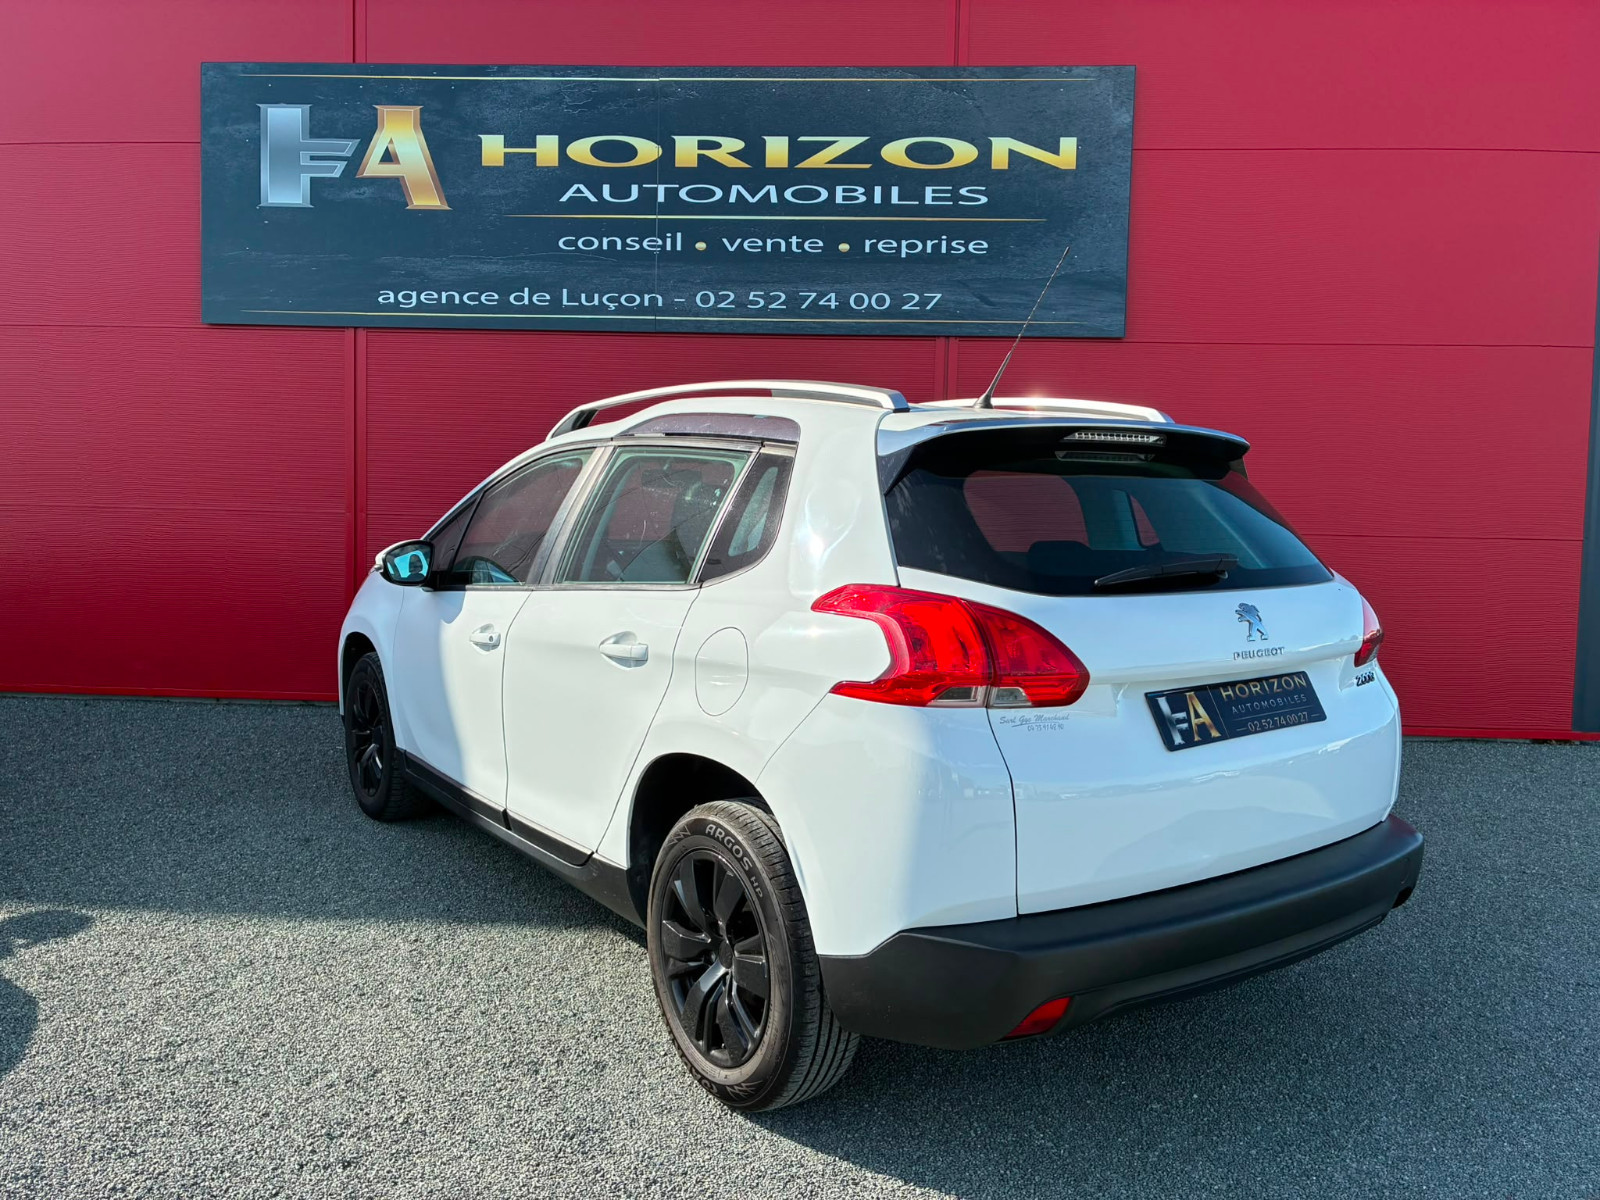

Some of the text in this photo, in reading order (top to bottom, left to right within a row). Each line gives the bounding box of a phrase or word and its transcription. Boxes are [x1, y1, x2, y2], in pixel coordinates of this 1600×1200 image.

[478, 134, 1078, 169] HORIZON
[558, 183, 989, 206] AUTOMOBILES
[558, 232, 989, 258] conseil vente reprise
[377, 288, 499, 308] agence
[509, 287, 552, 306] de
[561, 288, 663, 310] Luçon
[695, 291, 736, 309] 02
[746, 291, 788, 310] 52
[799, 292, 840, 310] 74
[849, 292, 891, 310] 00
[901, 292, 943, 310] 27
[1233, 647, 1285, 660] PEUGEOT
[1219, 674, 1308, 702] HORIZON
[1231, 693, 1308, 715] AUTOMOBILES
[705, 823, 763, 898] ARGOS HP
